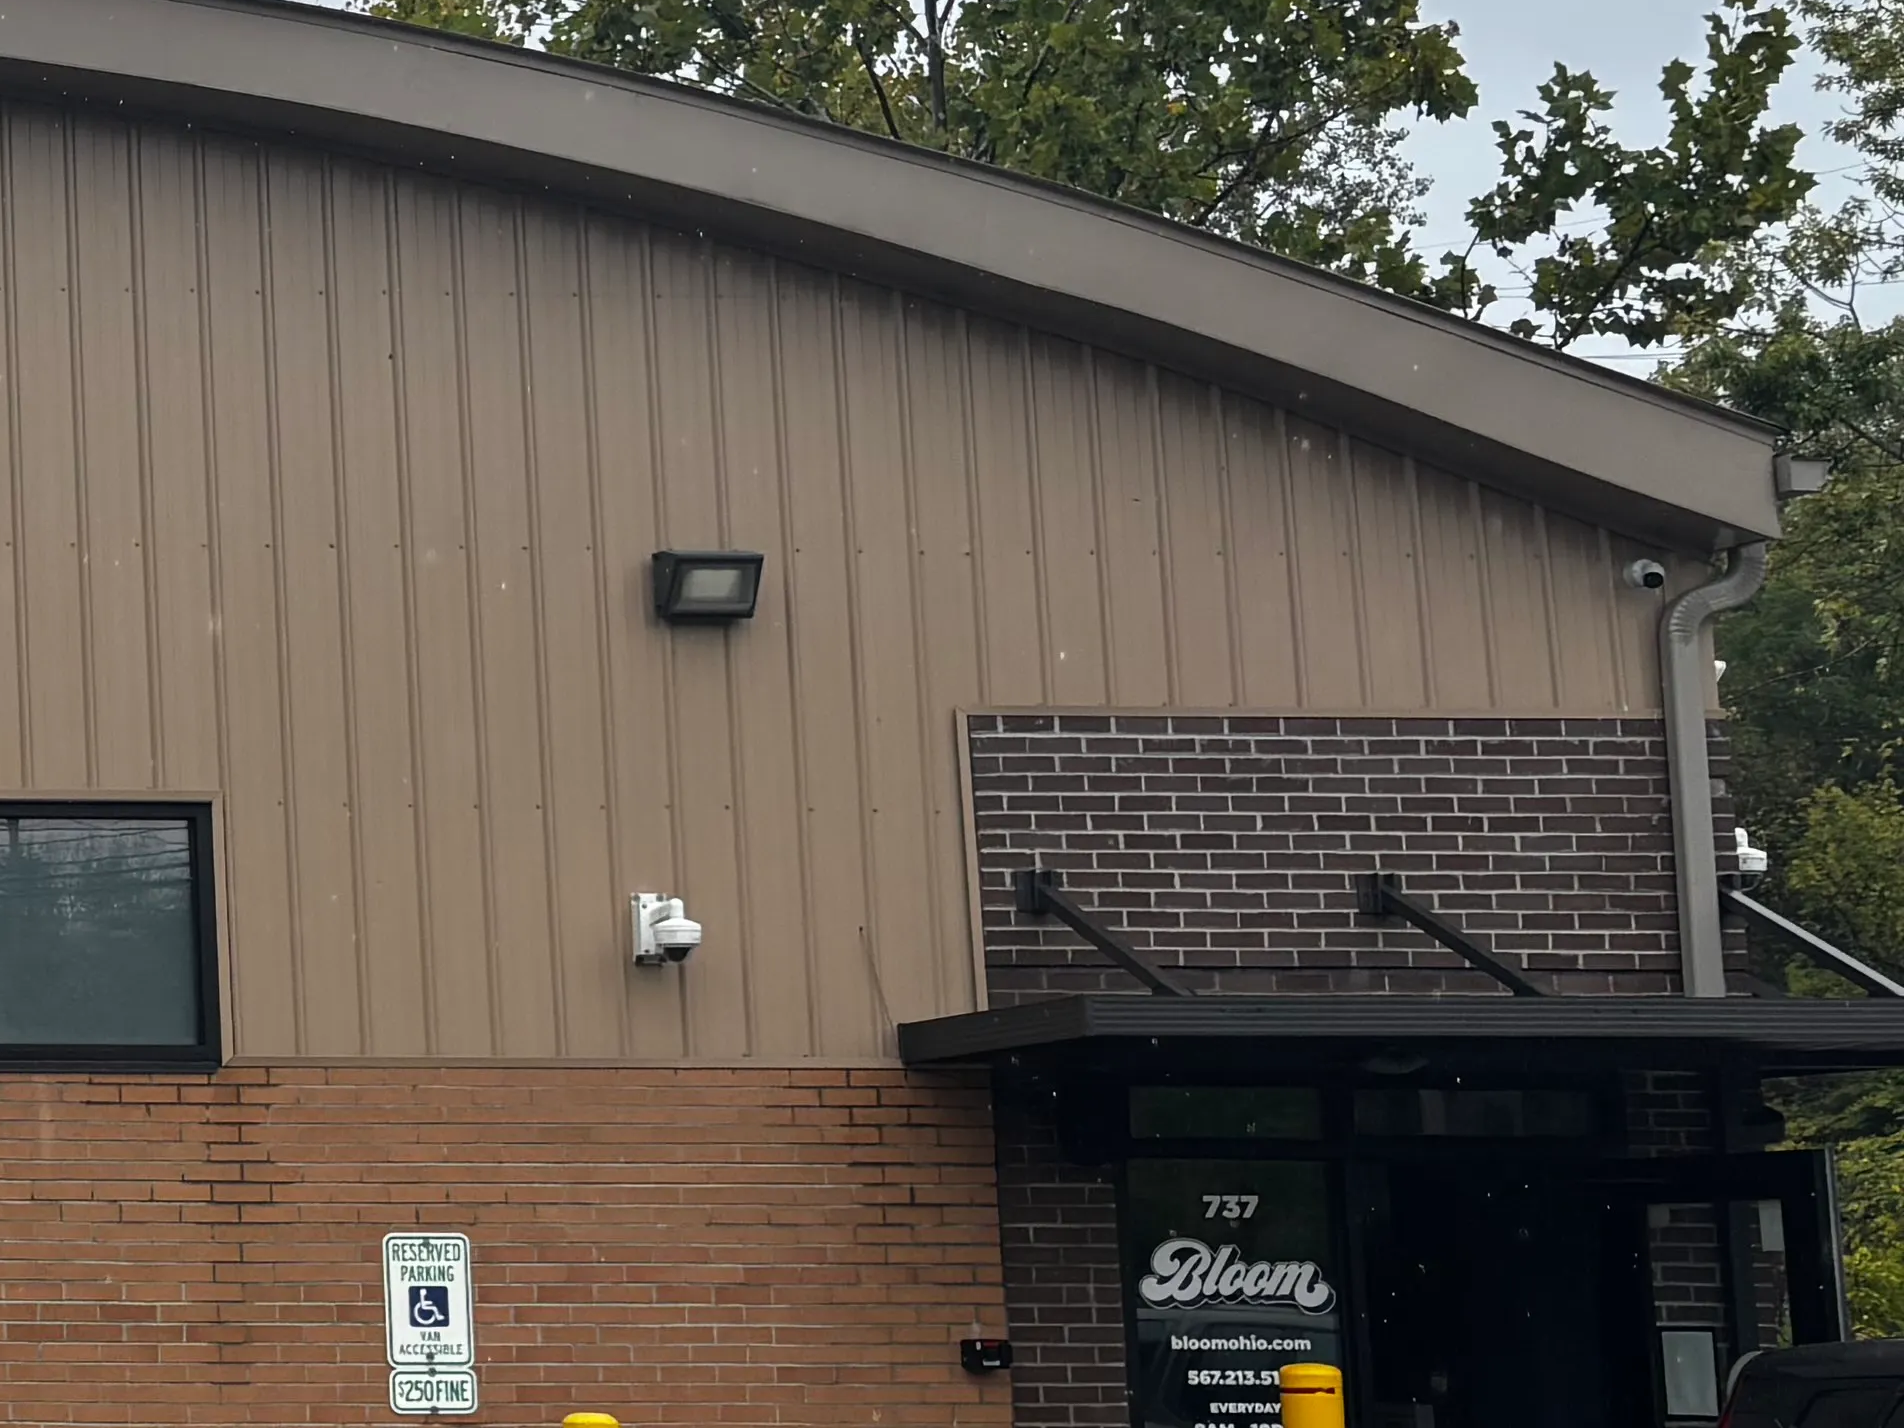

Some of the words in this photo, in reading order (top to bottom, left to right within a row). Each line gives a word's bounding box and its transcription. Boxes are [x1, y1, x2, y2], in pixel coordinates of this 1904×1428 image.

[1202, 1195, 1259, 1219] 737
[392, 1243, 461, 1262] RESERVED
[400, 1265, 455, 1282] PARKING
[1141, 1239, 1330, 1309] Bloom
[420, 1331, 441, 1342] VAN
[1171, 1334, 1312, 1350] bloomohio.com
[399, 1343, 463, 1356] ACCESSIBLE
[398, 1380, 434, 1403] $250
[436, 1380, 470, 1402] FINE
[1209, 1402, 1282, 1414] EVERYDAY
